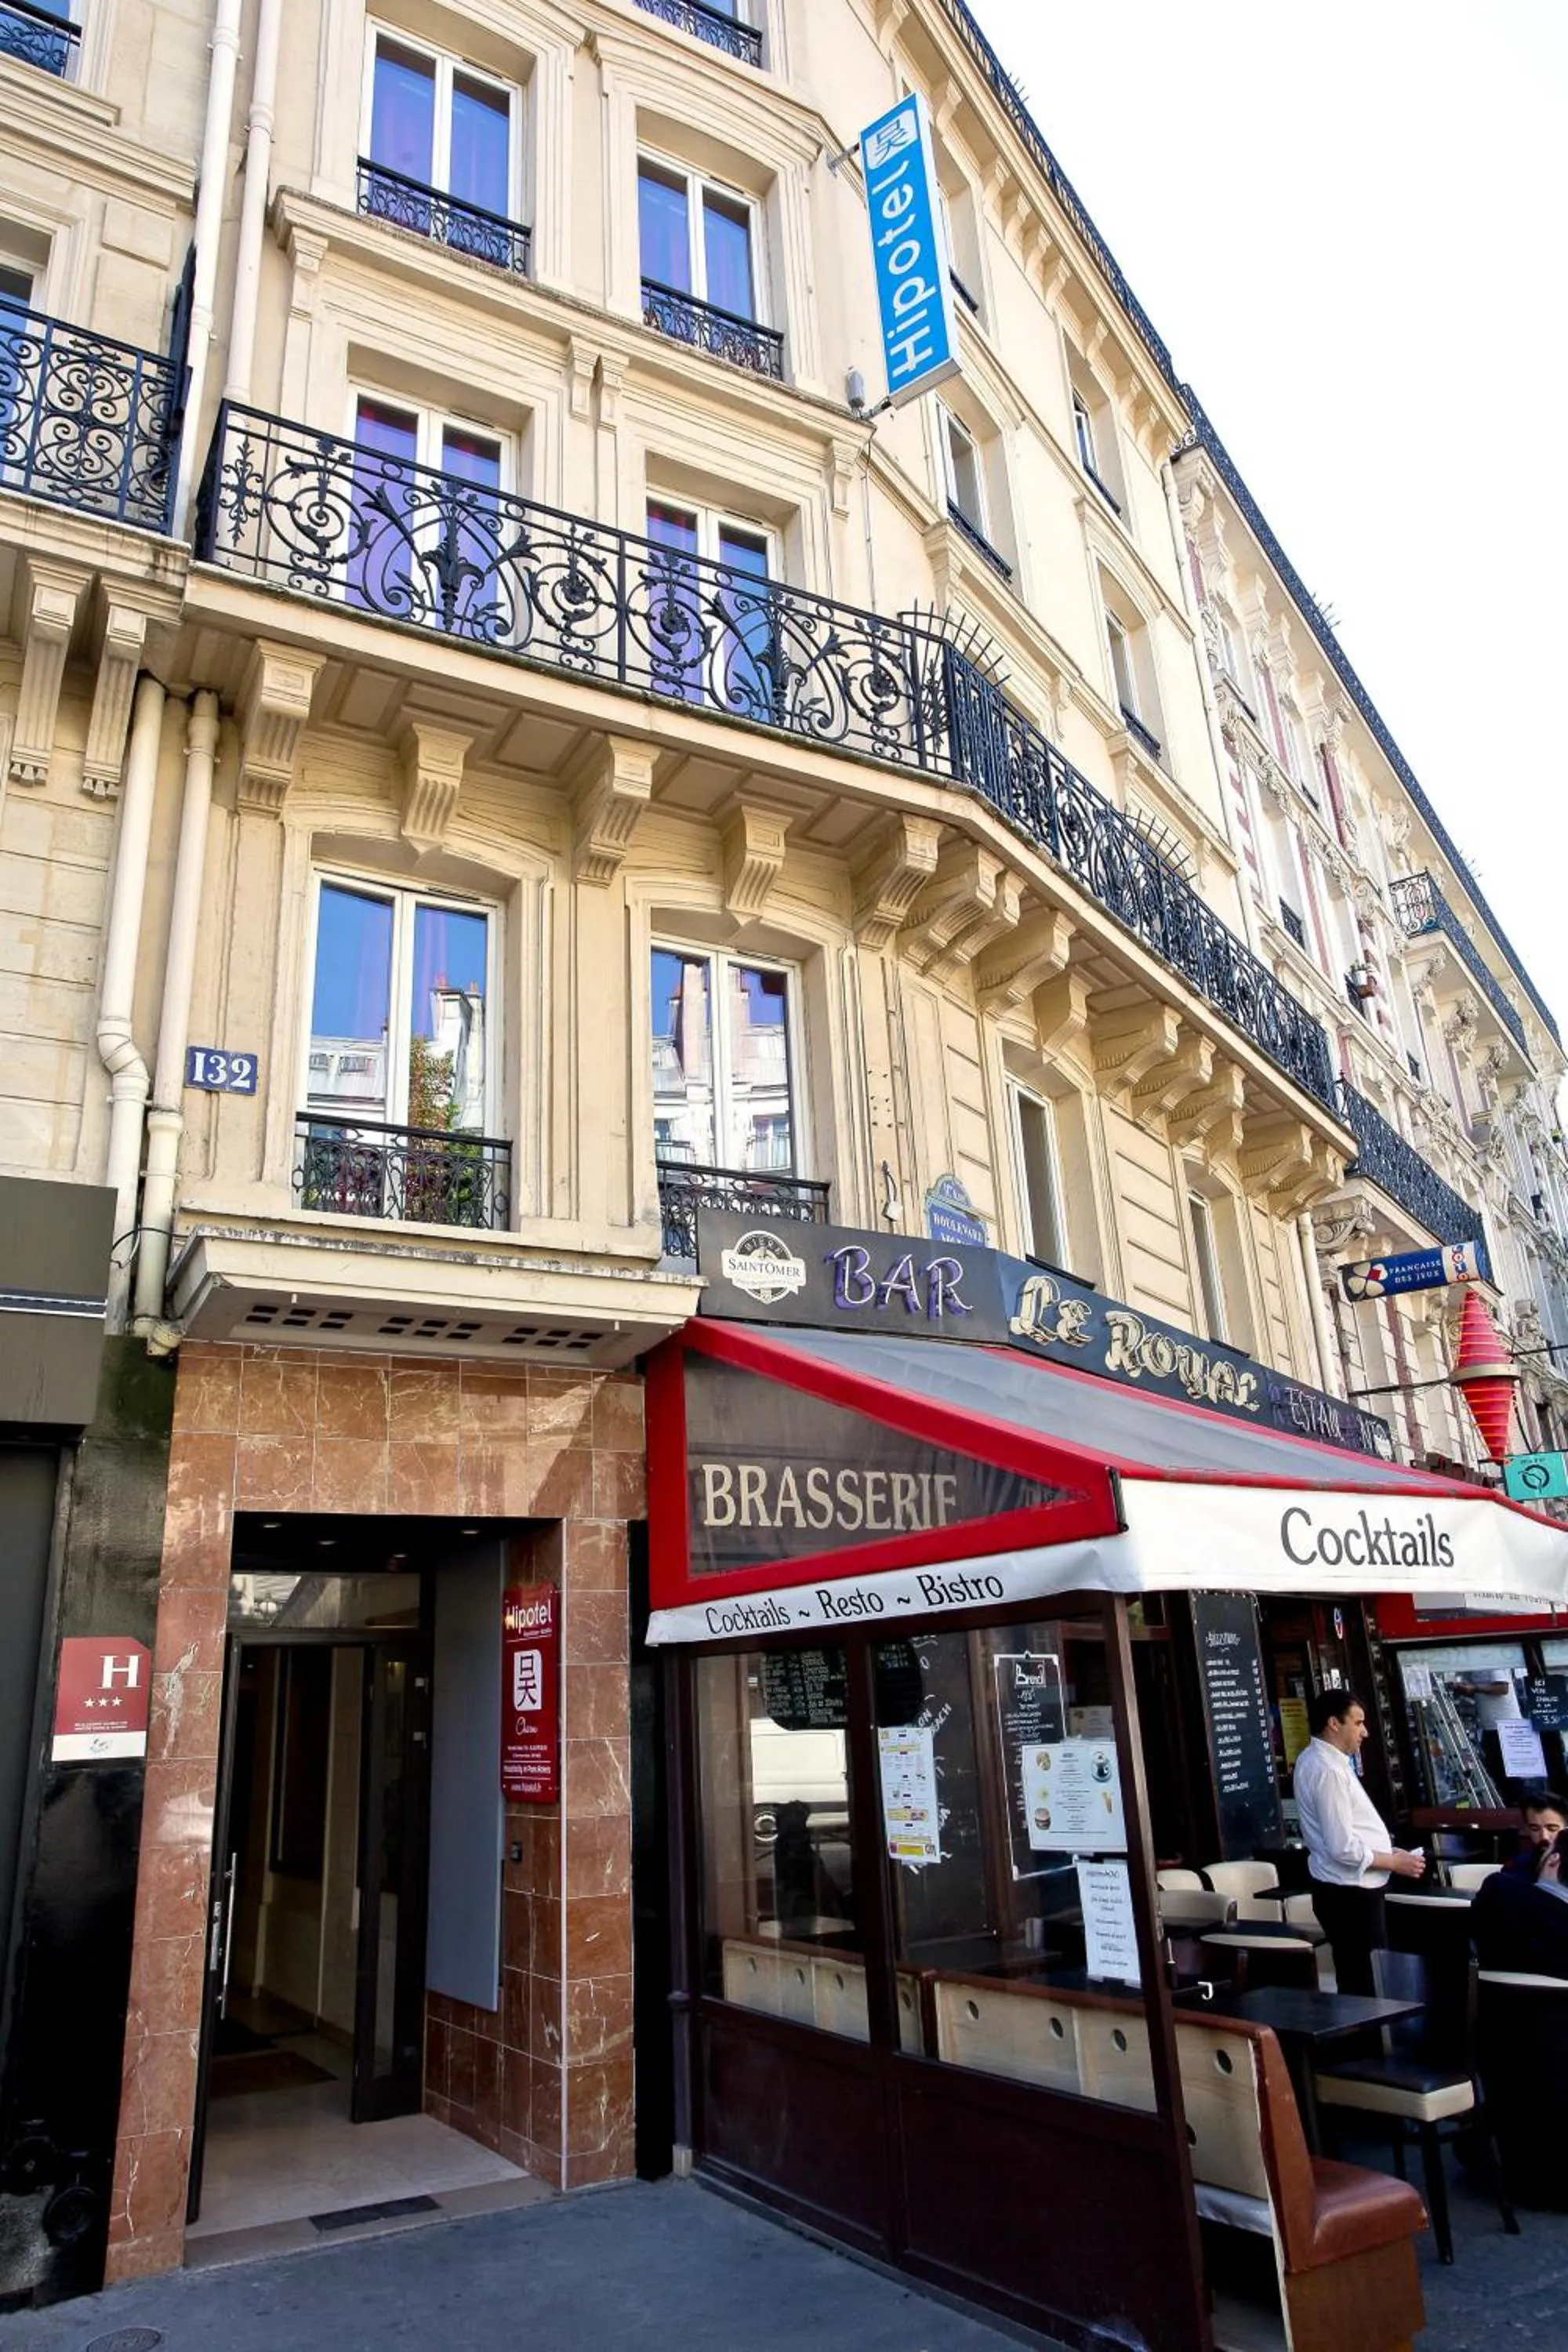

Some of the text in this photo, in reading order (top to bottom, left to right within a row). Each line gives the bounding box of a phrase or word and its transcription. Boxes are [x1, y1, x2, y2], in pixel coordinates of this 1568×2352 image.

[872, 159, 936, 378] Hipotel
[193, 1051, 252, 1088] 132
[824, 1246, 975, 1320] BAR
[702, 1464, 958, 1531] BRASSERIE
[1280, 1507, 1454, 1567] Cocktails
[505, 1599, 552, 1634] Hipotel
[706, 1598, 791, 1635] Cocktails
[815, 1588, 884, 1621] Resto
[916, 1573, 1004, 1607] Bistro
[96, 1655, 143, 1690] H
